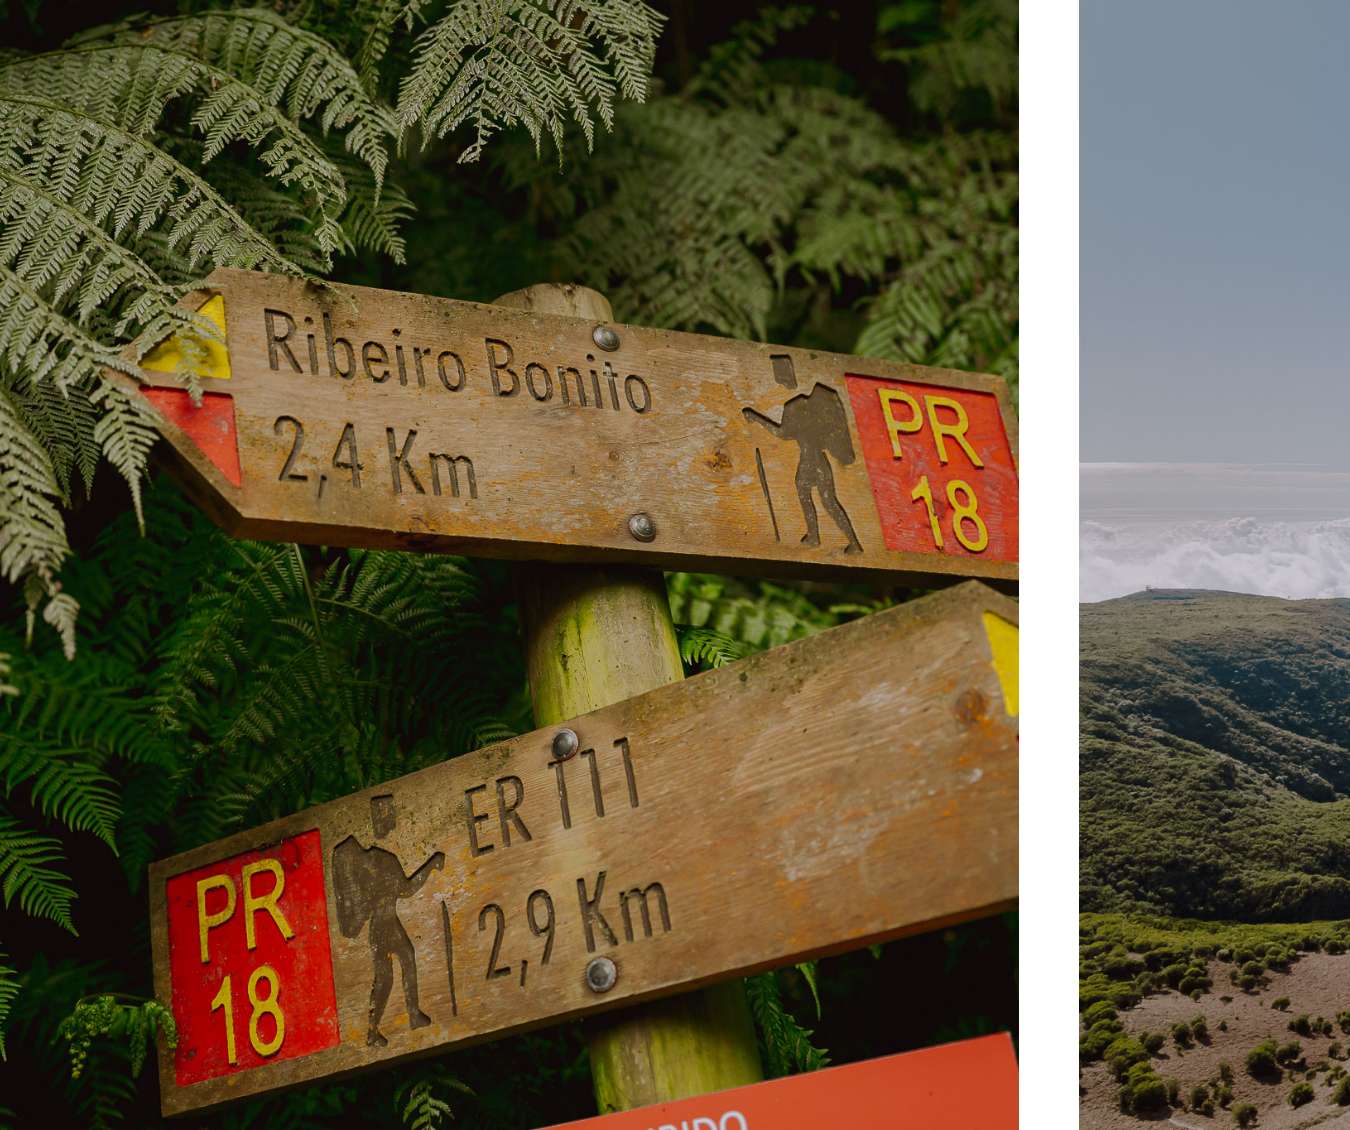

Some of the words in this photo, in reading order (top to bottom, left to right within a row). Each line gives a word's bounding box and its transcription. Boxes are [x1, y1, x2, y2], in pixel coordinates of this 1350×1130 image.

[263, 308, 466, 392] Ribeiro
[486, 338, 653, 414] Bonito
[273, 415, 364, 499] 2,4
[386, 426, 478, 499] Km
[878, 389, 984, 469] PR
[911, 475, 988, 554] 18
[464, 775, 532, 858] ER
[548, 736, 640, 829] 111
[197, 859, 295, 962] PR
[478, 888, 556, 987] 2,9
[576, 870, 672, 953] Km
[212, 966, 285, 1065] 18
